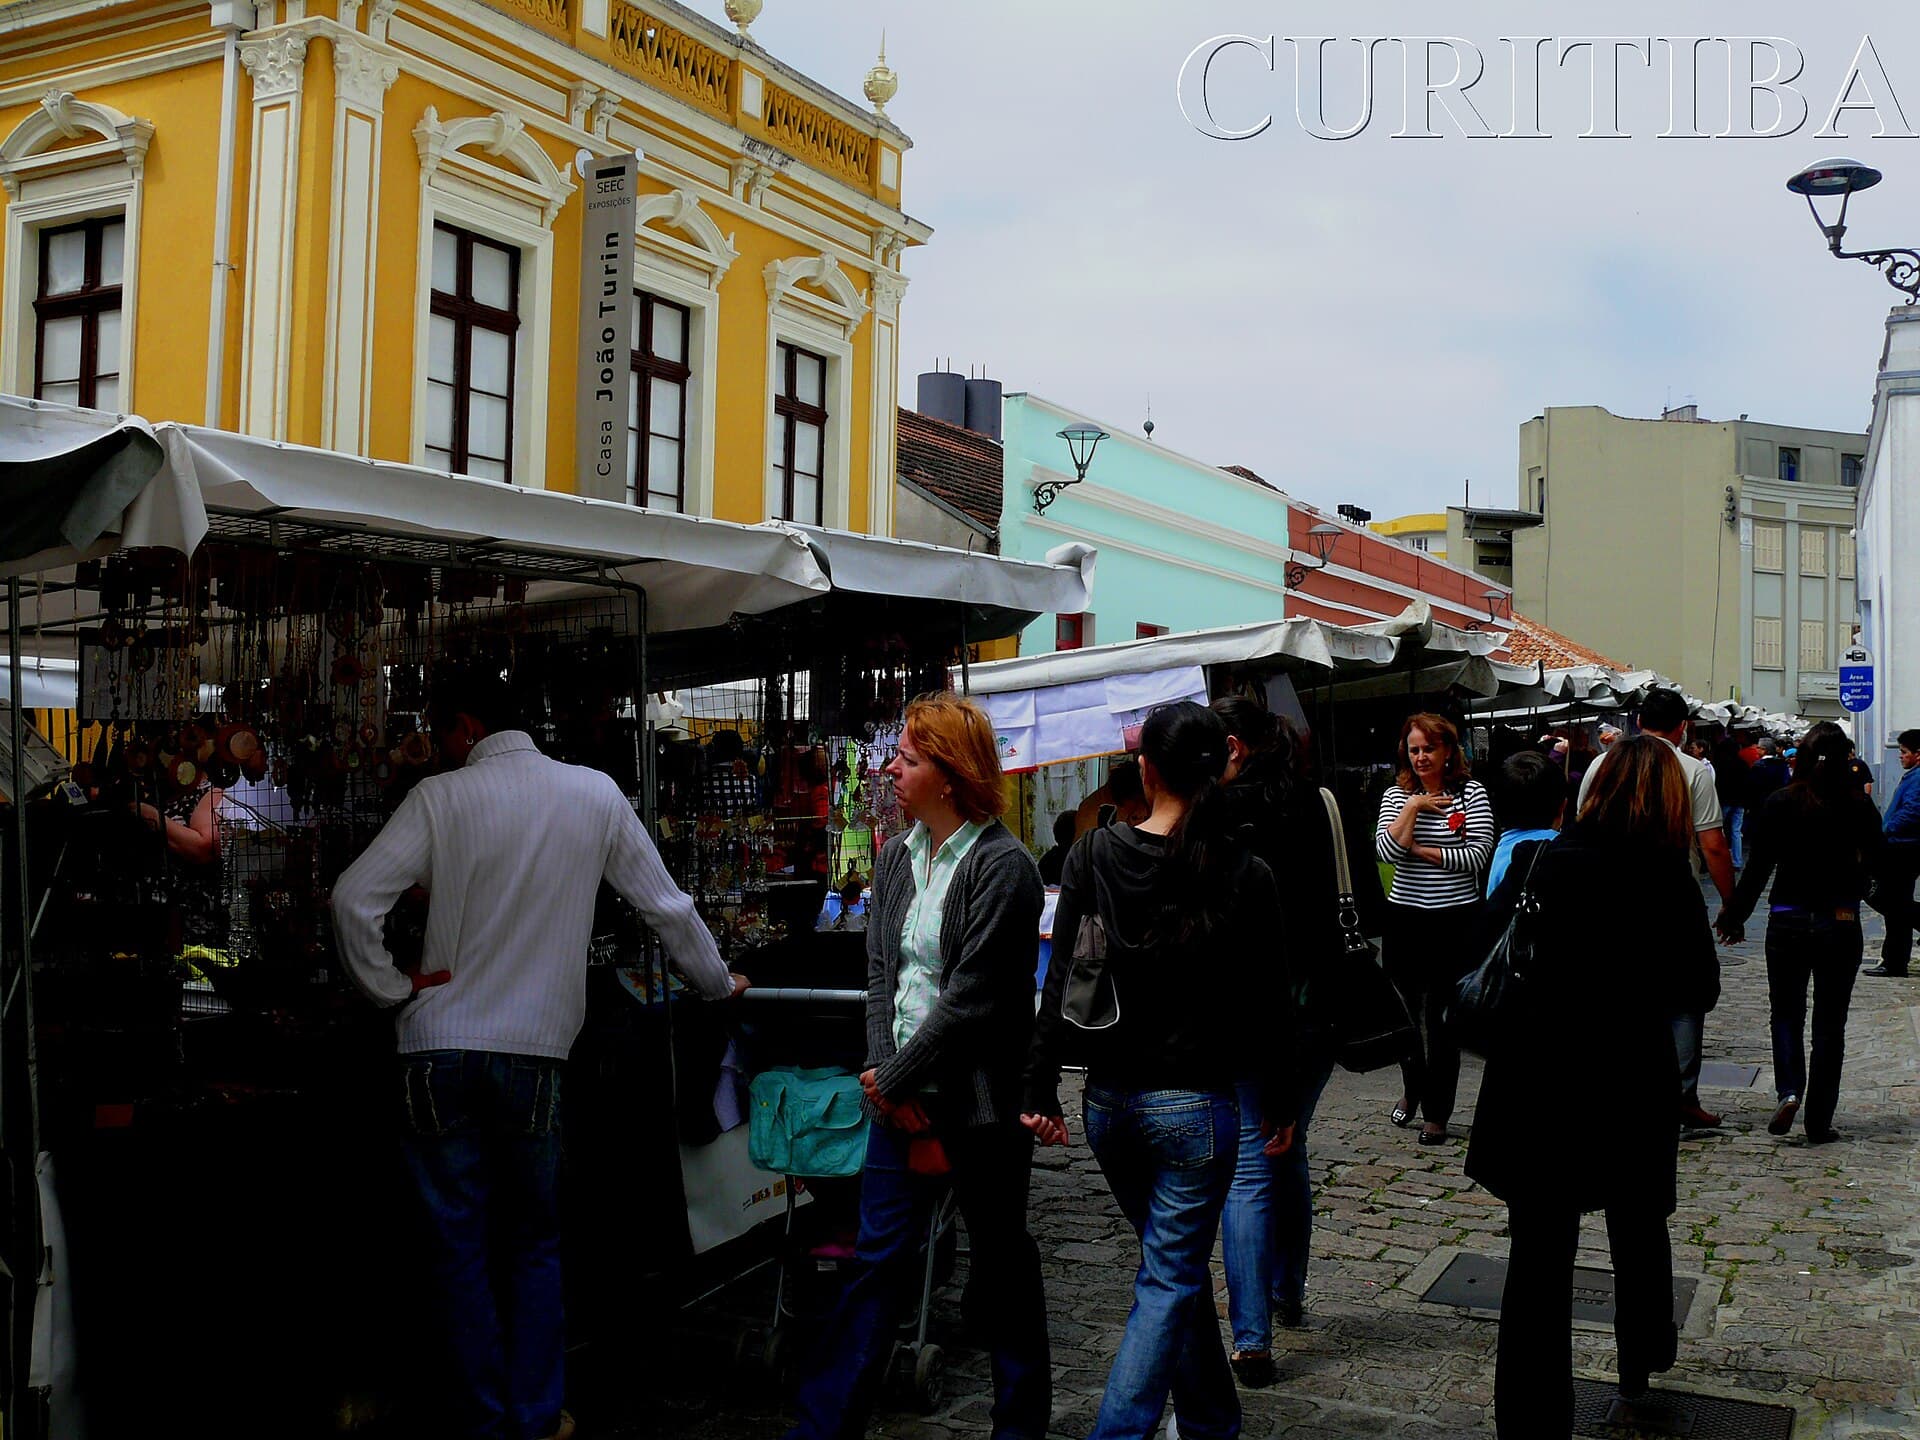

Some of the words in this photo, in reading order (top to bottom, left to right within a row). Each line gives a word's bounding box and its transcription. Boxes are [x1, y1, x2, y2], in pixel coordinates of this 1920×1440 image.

[588, 196, 632, 210] EXPOSIÇÕES
[597, 179, 625, 194] SEEC
[599, 232, 619, 319] Turin
[596, 327, 616, 402] João
[596, 421, 613, 476] Casa
